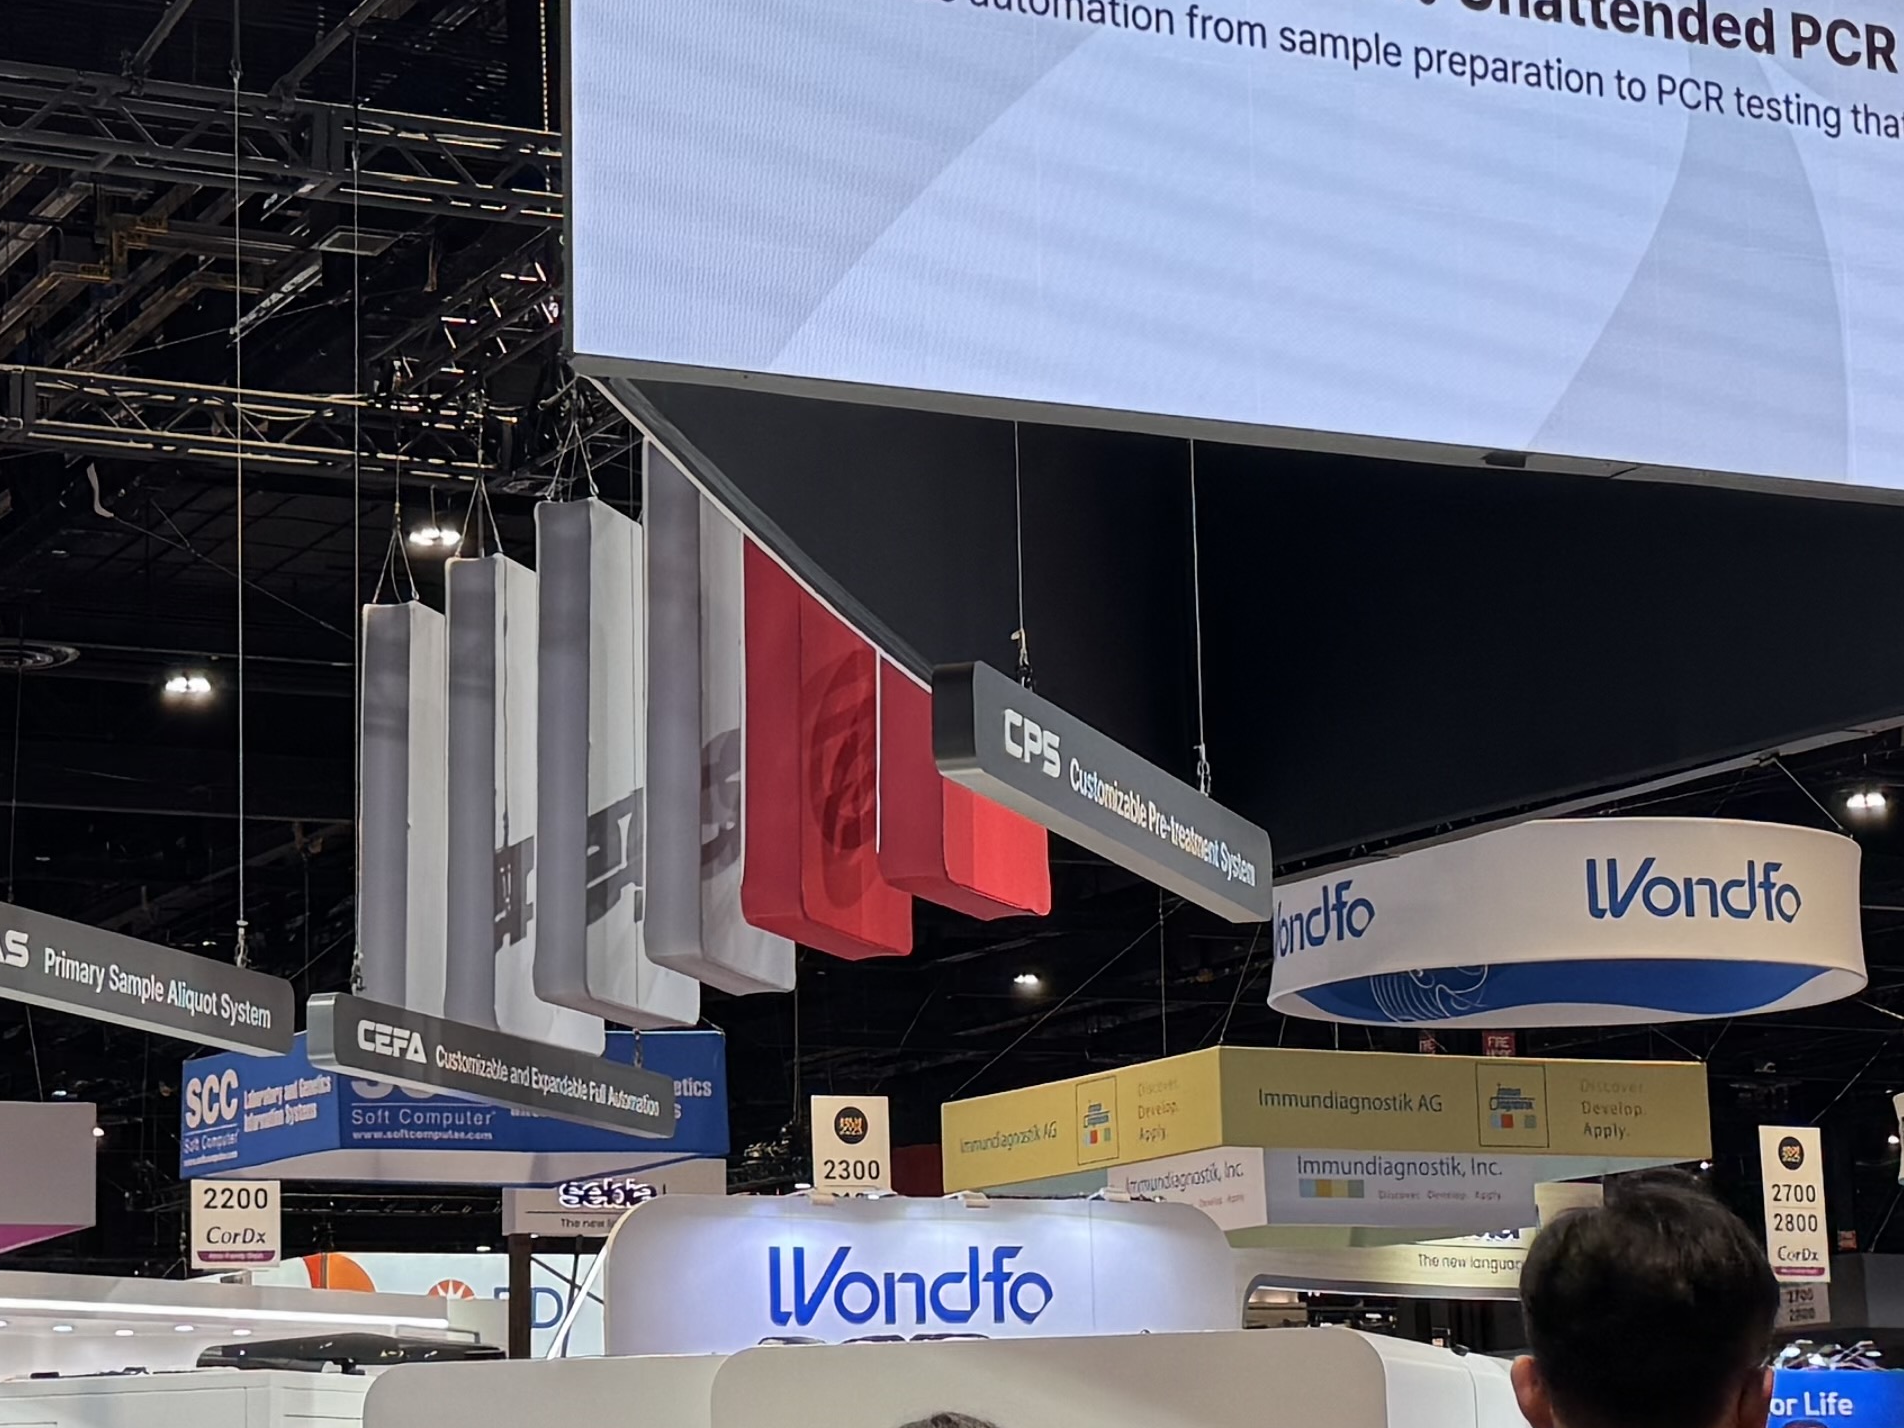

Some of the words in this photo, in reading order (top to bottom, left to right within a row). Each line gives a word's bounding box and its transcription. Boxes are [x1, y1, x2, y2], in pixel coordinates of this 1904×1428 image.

[1793, 12, 1898, 74] PCR
[1187, 5, 1267, 48] from
[1279, 27, 1401, 70] sample
[1414, 44, 1604, 98] preparation
[1615, 69, 1646, 103] to
[1658, 74, 1725, 114] PCR
[1735, 86, 1841, 138] testing
[1005, 708, 1061, 778] CPS
[1070, 757, 1146, 829] Customizable
[1148, 800, 1219, 870] Pre-treatment
[1220, 841, 1255, 887] System
[1585, 857, 1802, 923] Wondfo
[45, 947, 106, 993] Primary
[109, 964, 164, 1003] Sample
[167, 980, 217, 1016] Aliquot
[221, 993, 271, 1029] System
[357, 1020, 428, 1064] CEFA
[436, 1045, 509, 1082] Customizable
[510, 1064, 530, 1085] and
[532, 1067, 588, 1100] Expandable
[590, 1082, 606, 1103] Full
[608, 1086, 660, 1117] Automation
[186, 1069, 239, 1129] SCC
[674, 1077, 712, 1096] etics
[1259, 1088, 1412, 1114] Immundiagnostik
[1418, 1095, 1442, 1112] AG
[352, 1109, 389, 1124] Soft
[399, 1109, 493, 1127] Computer
[960, 1123, 1040, 1154] Immundiagnostik
[1043, 1121, 1057, 1140] AG
[824, 1159, 880, 1180] 2300
[1297, 1155, 1465, 1180] Immundiagnostik,
[1471, 1157, 1502, 1176] Inc.
[204, 1188, 267, 1209] 2200
[1772, 1184, 1816, 1202] 2700
[207, 1226, 266, 1244] CorDx
[1774, 1213, 1818, 1232] 2800
[1418, 1254, 1439, 1267] The
[1777, 1246, 1819, 1261] CorDx
[768, 1245, 1054, 1326] Wondfo
[1770, 1399, 1798, 1416] or
[1804, 1392, 1853, 1416] Life
